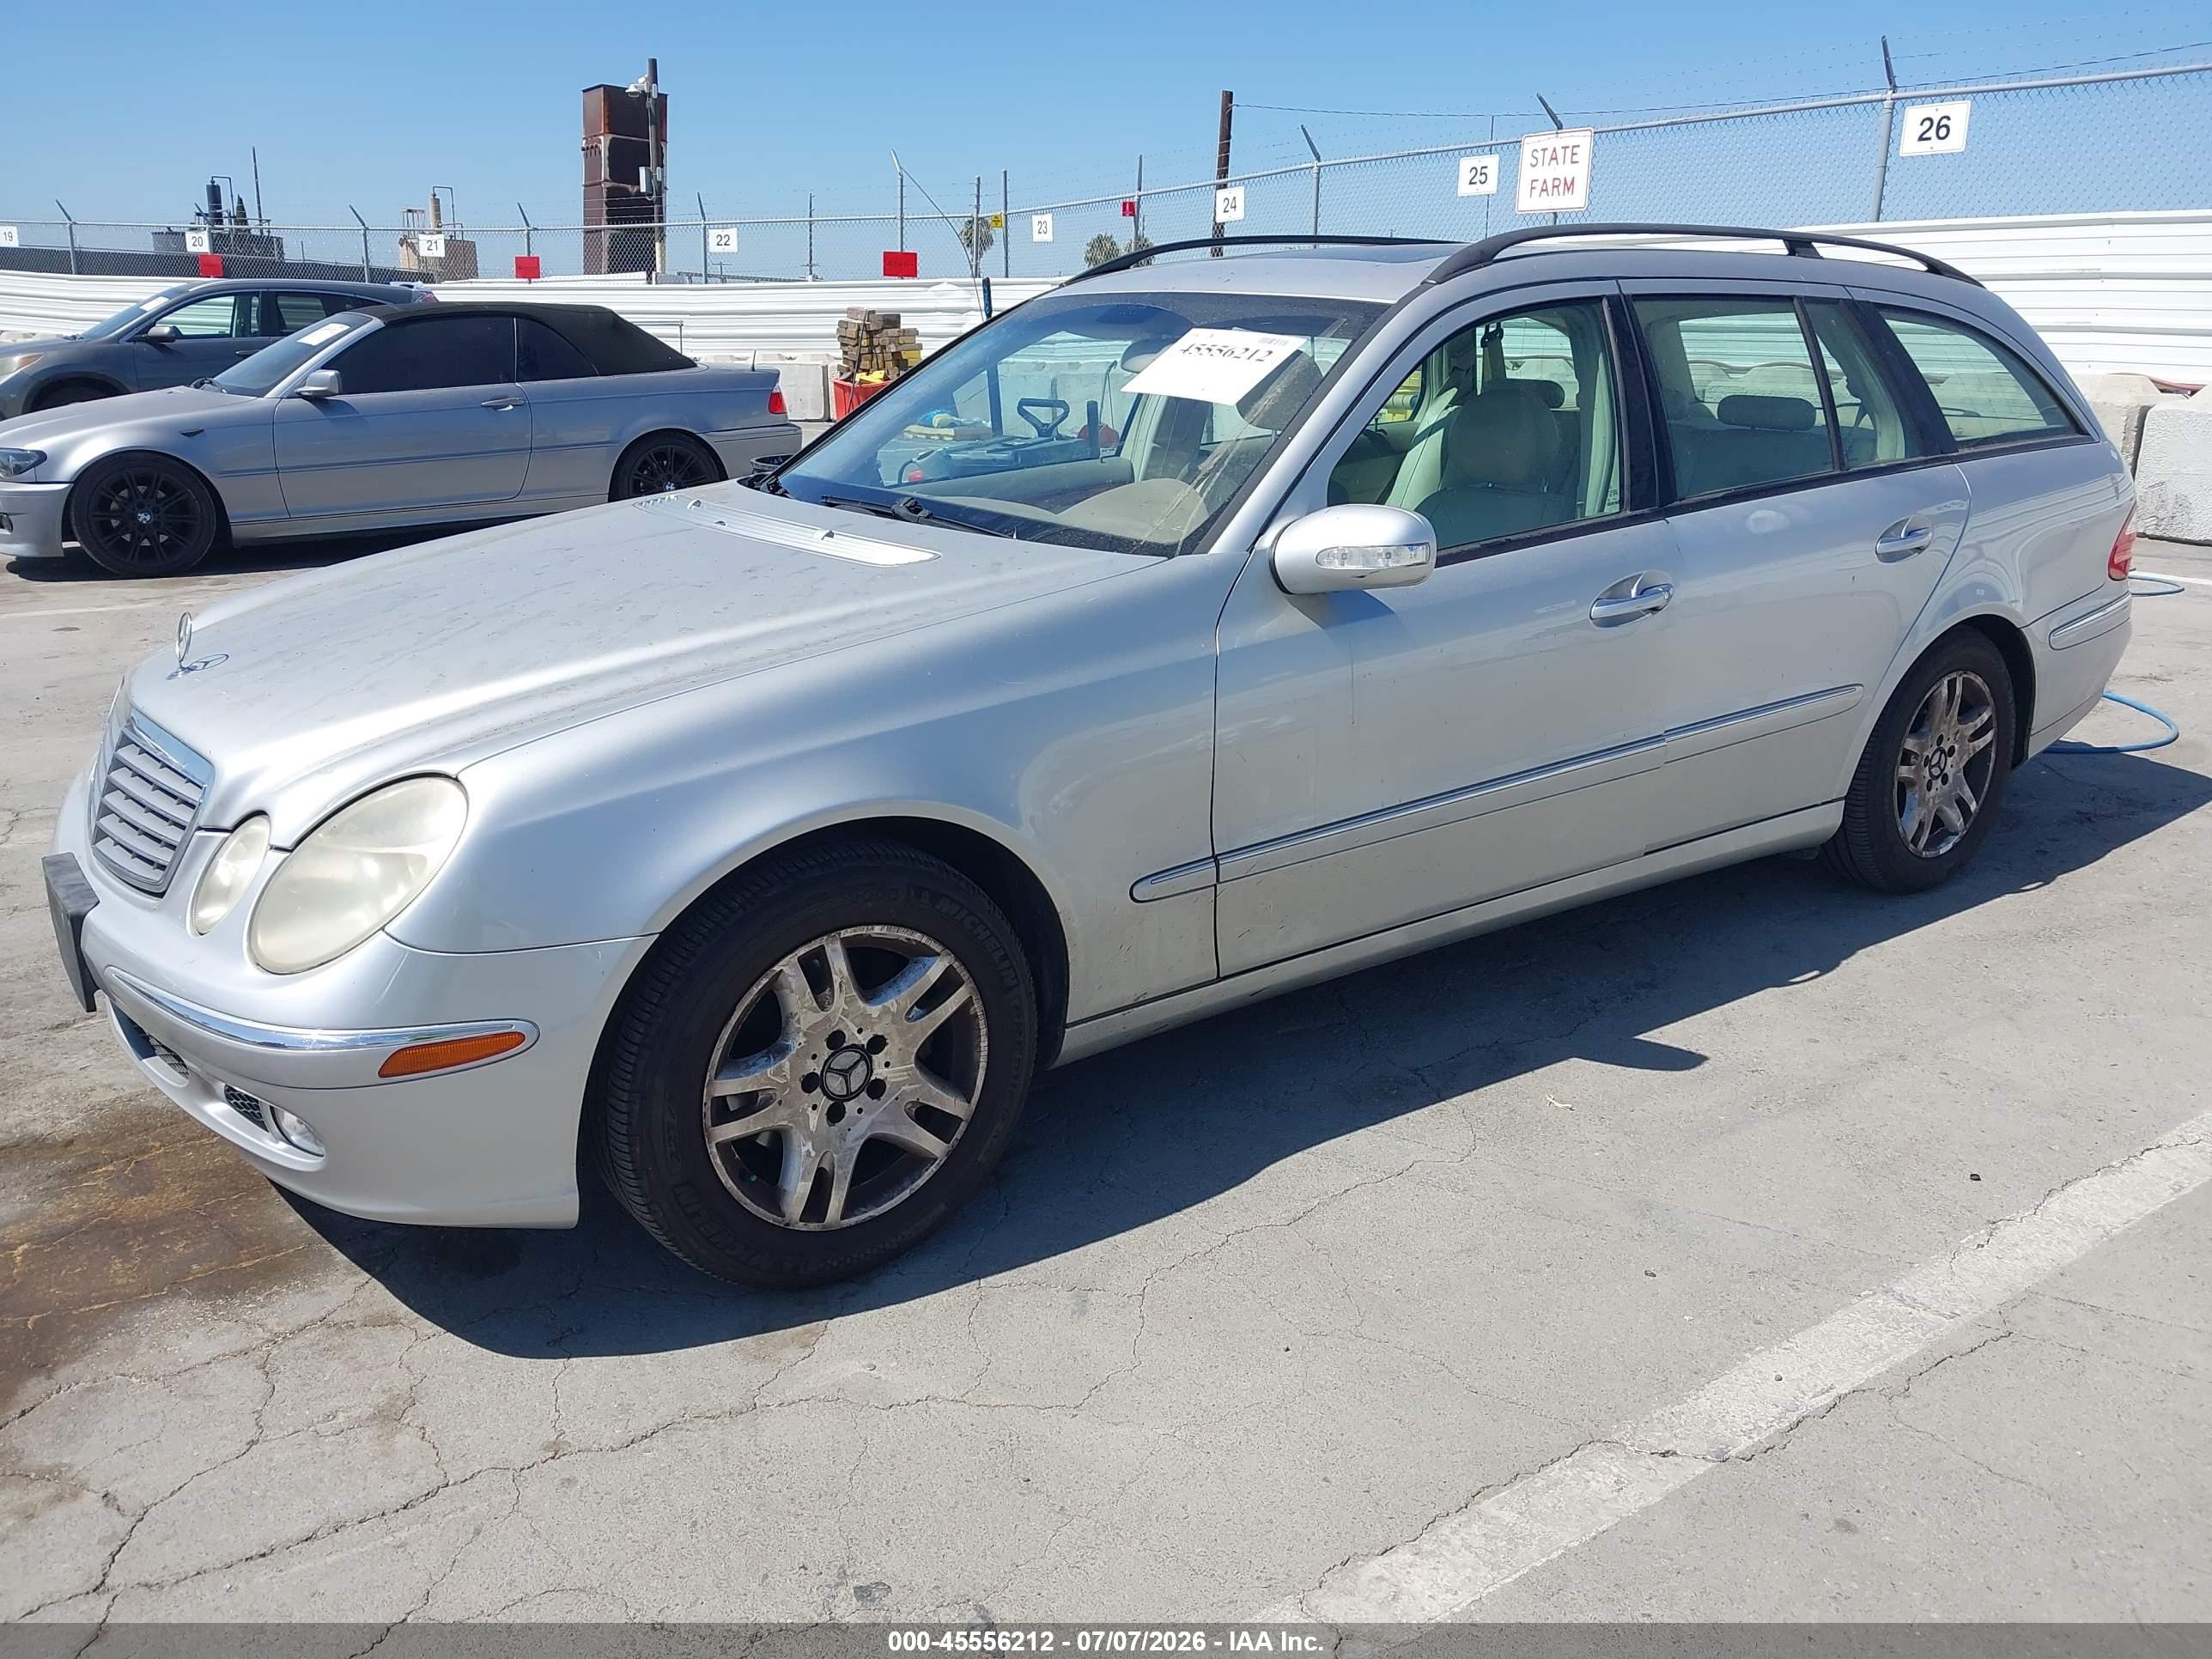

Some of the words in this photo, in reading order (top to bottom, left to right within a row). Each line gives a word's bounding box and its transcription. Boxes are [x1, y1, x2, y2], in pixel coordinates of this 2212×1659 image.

[1917, 115, 1951, 142] 26
[1529, 144, 1580, 167] STATE
[1468, 166, 1488, 185] 25
[1529, 176, 1575, 198] FARM
[1223, 196, 1237, 213] 24
[3, 230, 14, 242] 19
[1037, 220, 1048, 234] 23
[191, 235, 204, 247] 20
[427, 240, 439, 252] 21
[716, 234, 731, 246] 22
[1180, 343, 1273, 362] 45556212
[934, 894, 1020, 992] MICHELIN
